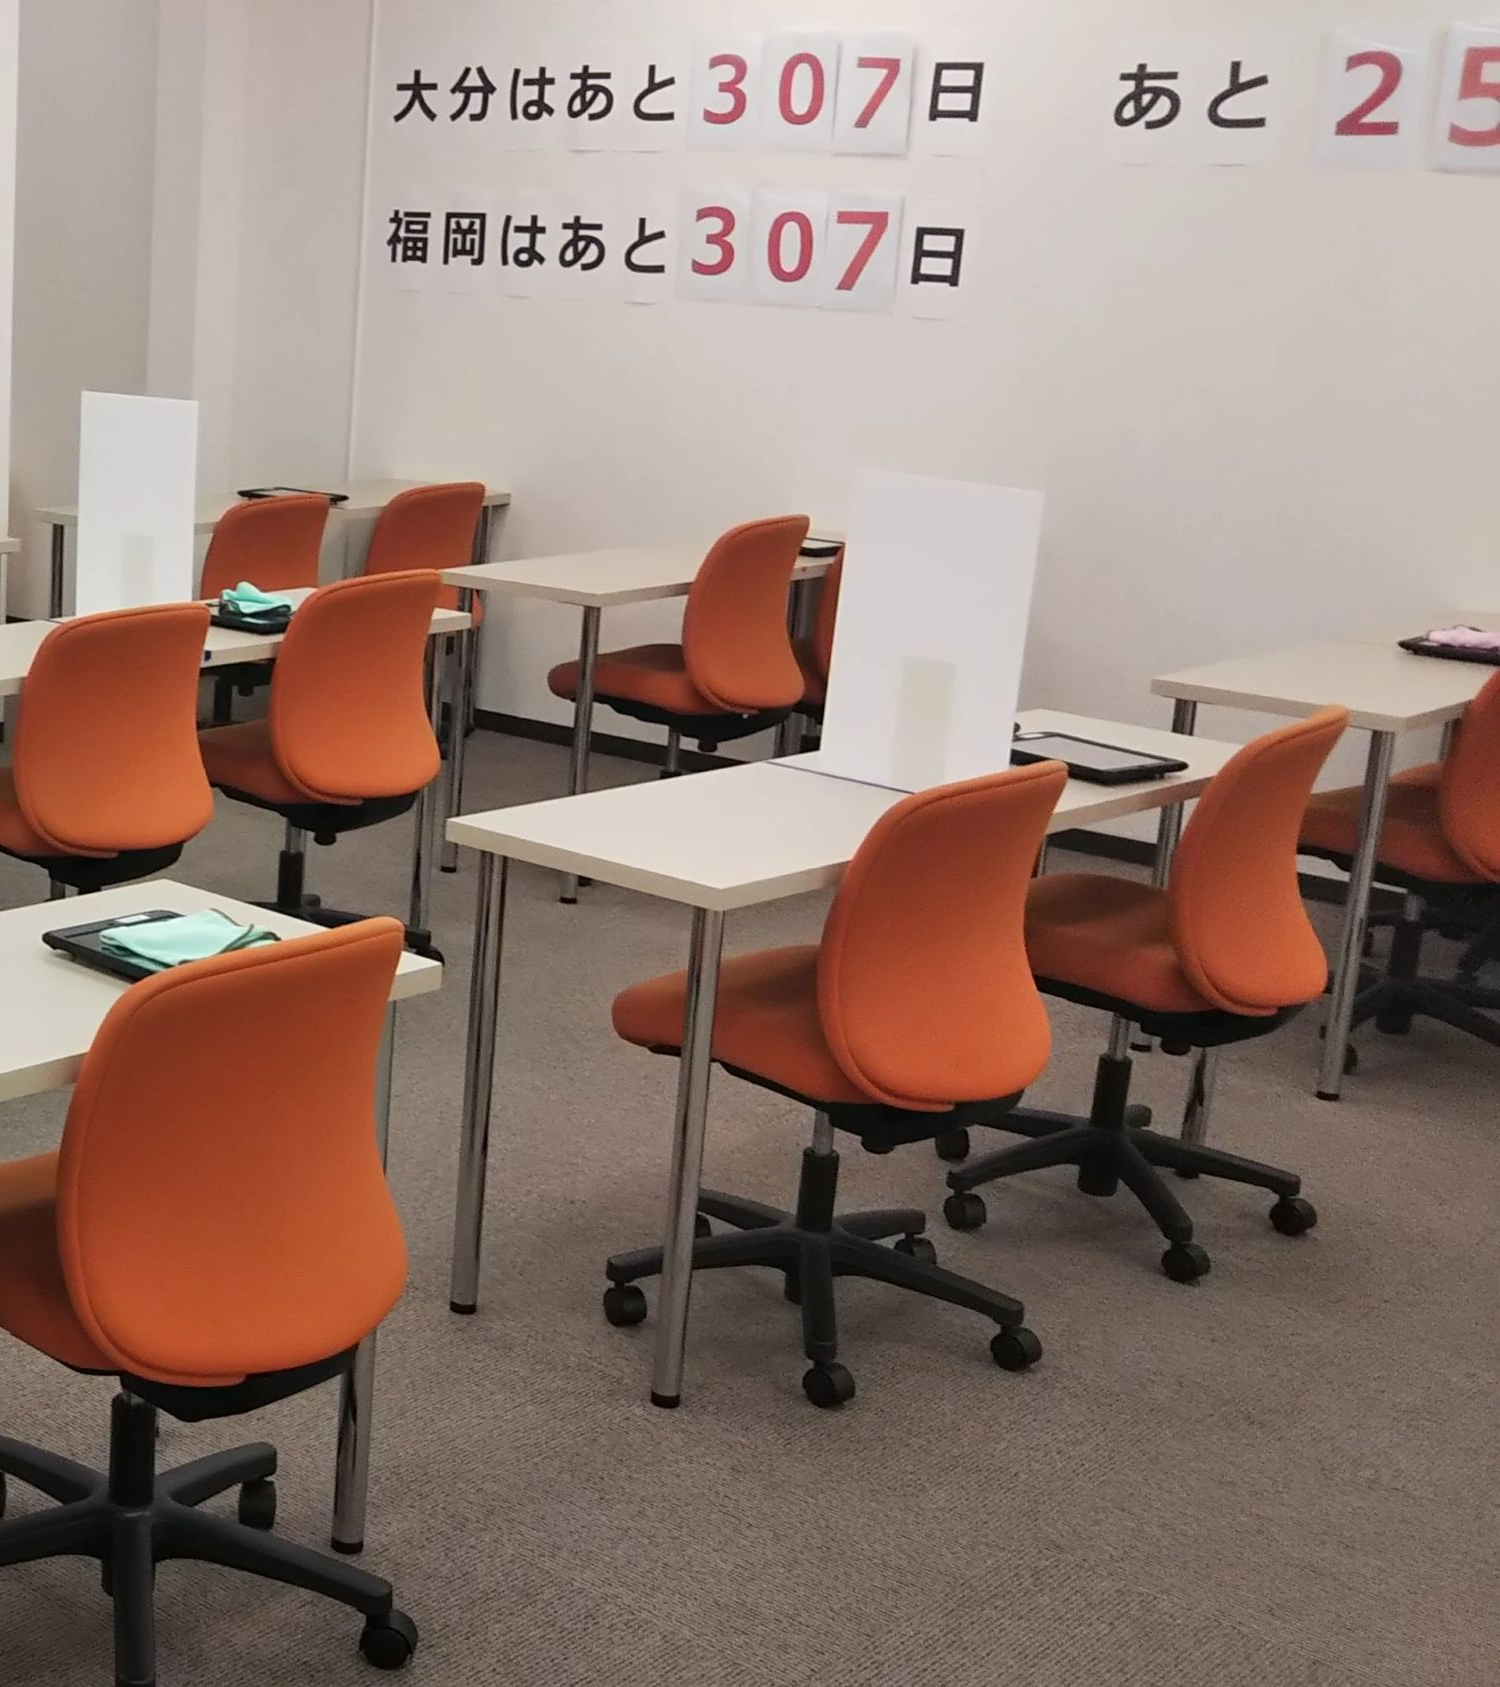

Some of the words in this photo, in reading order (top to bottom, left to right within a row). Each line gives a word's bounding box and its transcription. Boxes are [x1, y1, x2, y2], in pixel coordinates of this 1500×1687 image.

[393, 53, 984, 128] 大分はあと307日
[387, 207, 965, 291] 福岡はあと307日
